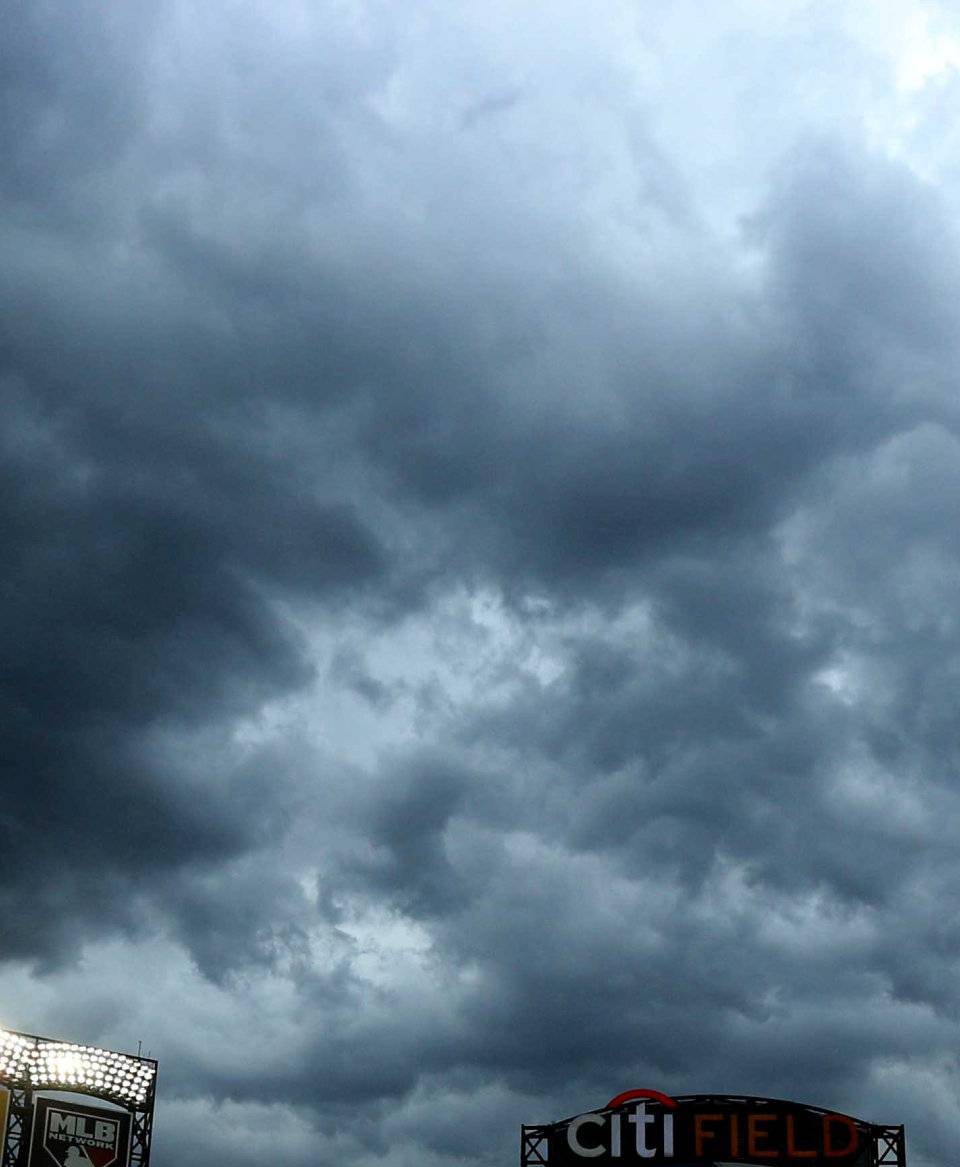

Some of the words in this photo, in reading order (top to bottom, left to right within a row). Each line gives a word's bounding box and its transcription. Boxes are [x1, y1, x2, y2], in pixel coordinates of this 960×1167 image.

[48, 1112, 116, 1143] MLB
[48, 1131, 114, 1151] NETWORK
[567, 1102, 674, 1158] citi
[693, 1112, 860, 1160] FIELD
